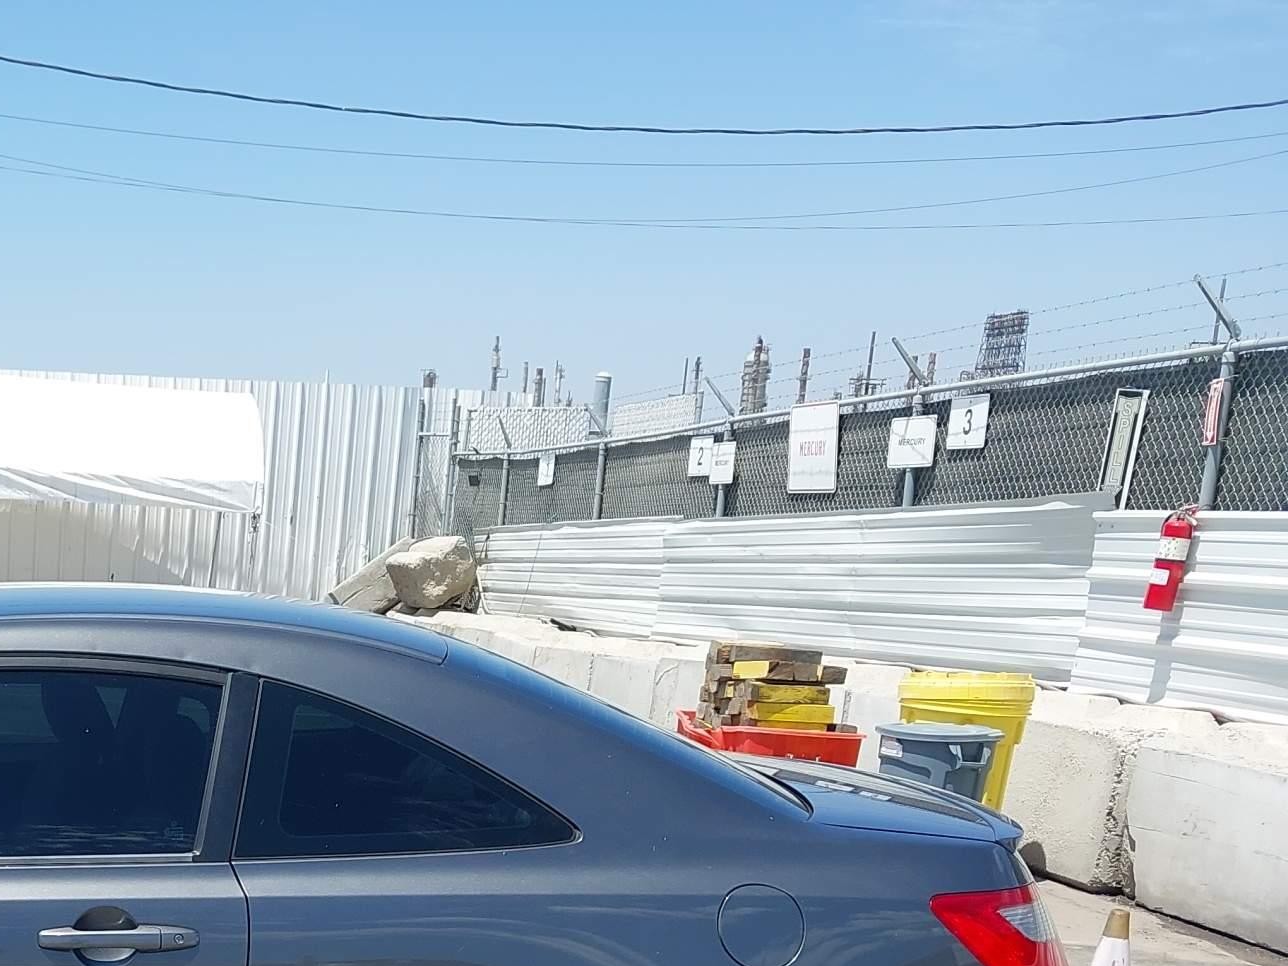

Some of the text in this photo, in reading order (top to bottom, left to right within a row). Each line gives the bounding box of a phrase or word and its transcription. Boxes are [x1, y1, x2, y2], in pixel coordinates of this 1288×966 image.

[962, 408, 973, 436] 3
[799, 439, 827, 457] MERCURY
[898, 437, 926, 447] MERCURY
[1109, 402, 1133, 484] SPILL
[697, 446, 704, 466] 2
